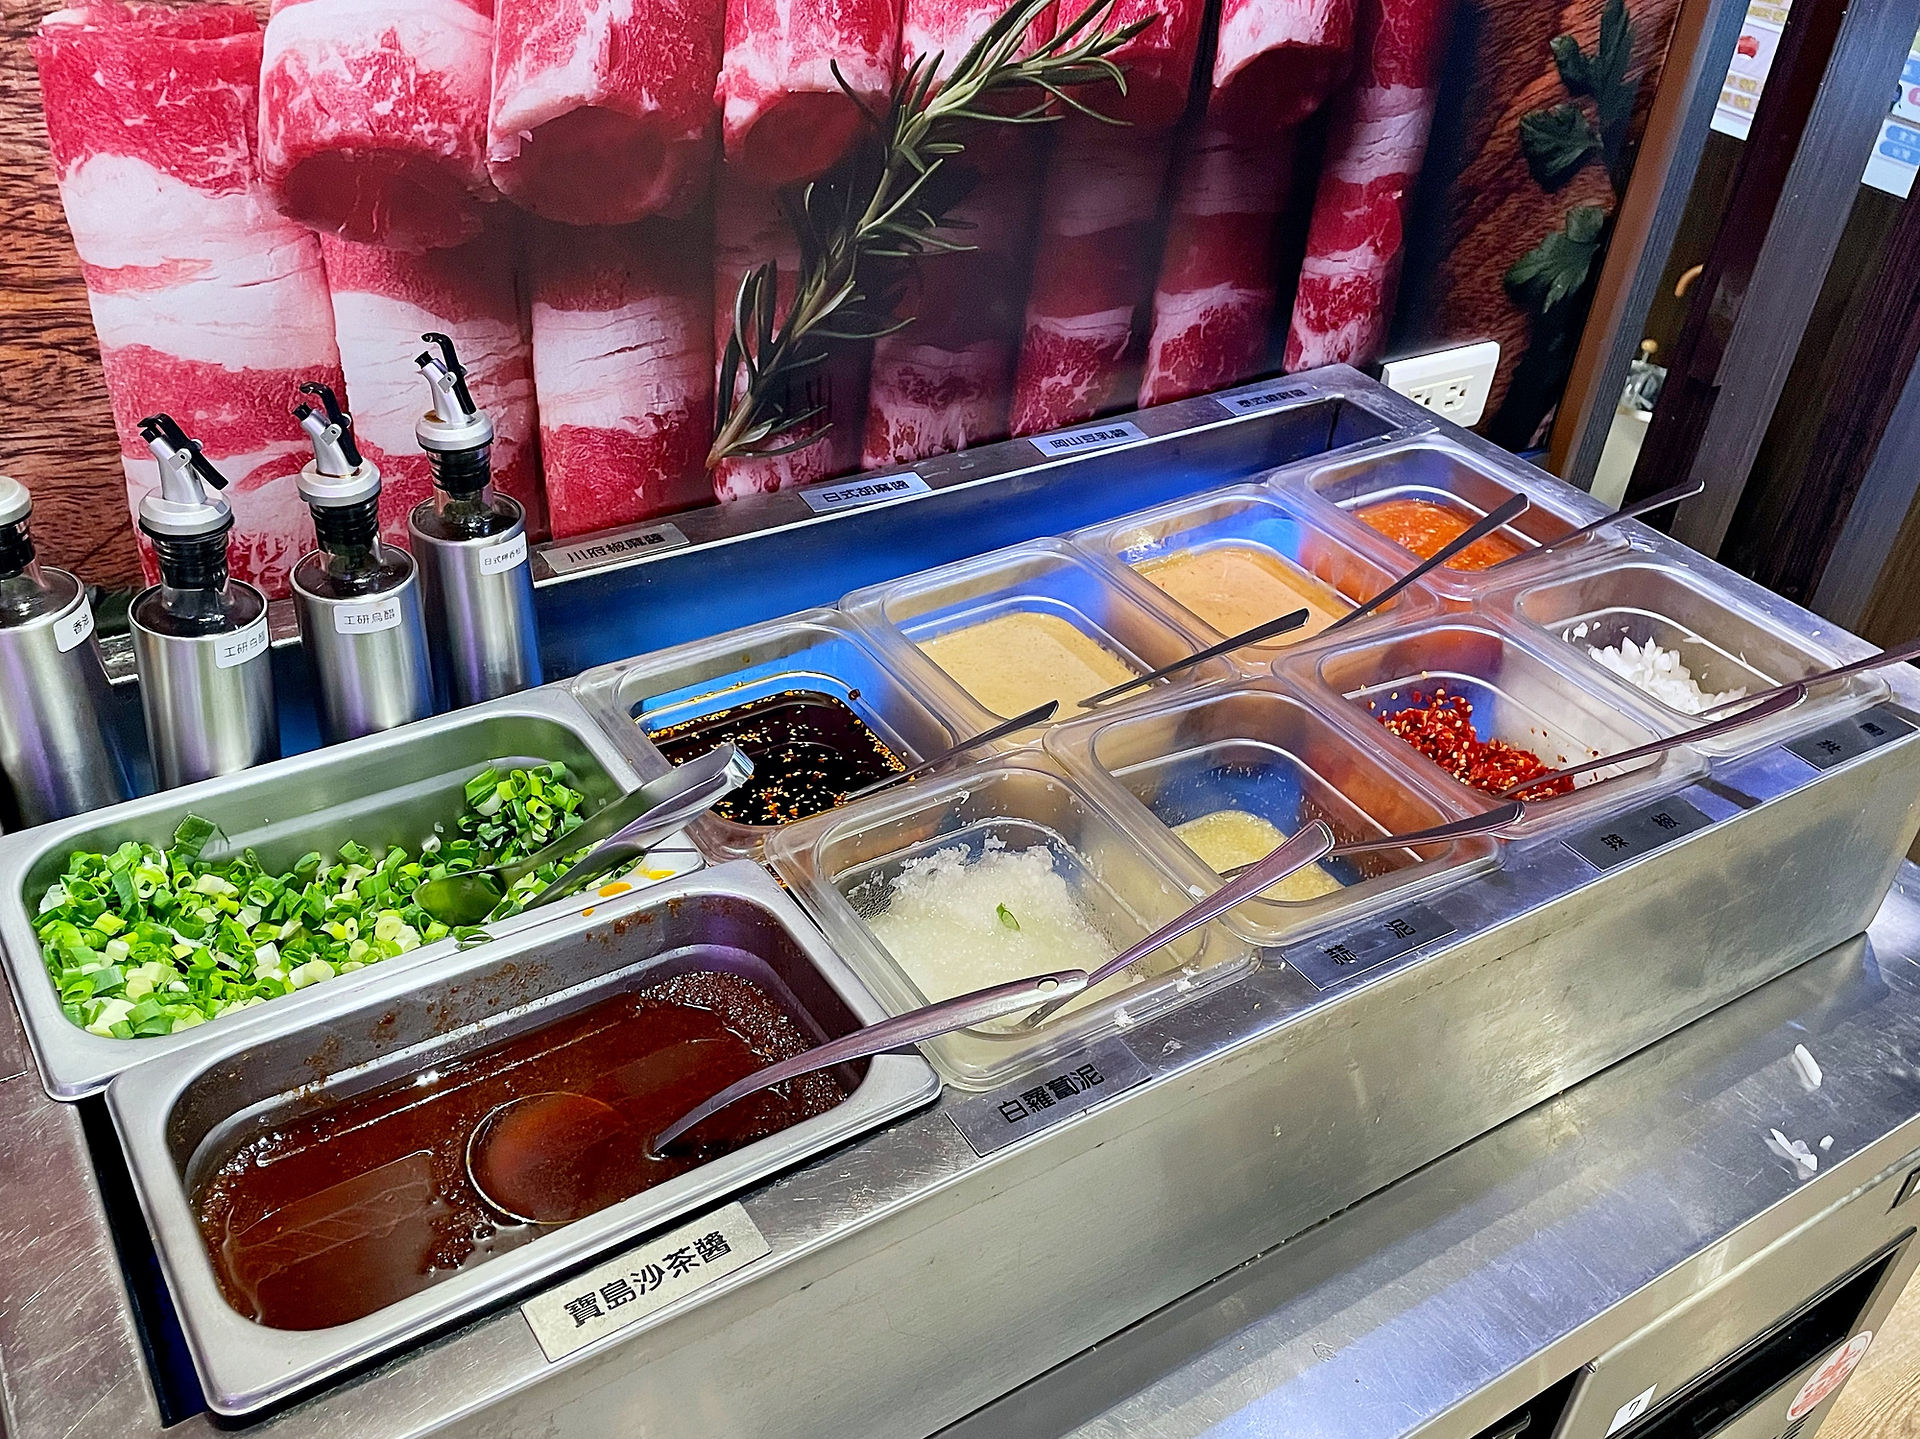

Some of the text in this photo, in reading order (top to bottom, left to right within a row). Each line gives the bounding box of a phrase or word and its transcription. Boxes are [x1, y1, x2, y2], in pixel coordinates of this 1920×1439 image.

[1049, 428, 1129, 449] 岡山豆乳醬
[822, 479, 910, 503] 日式胡麻醬
[566, 533, 666, 563] 川府椒麻醬
[563, 1230, 733, 1329] 寶島沙茶醬
